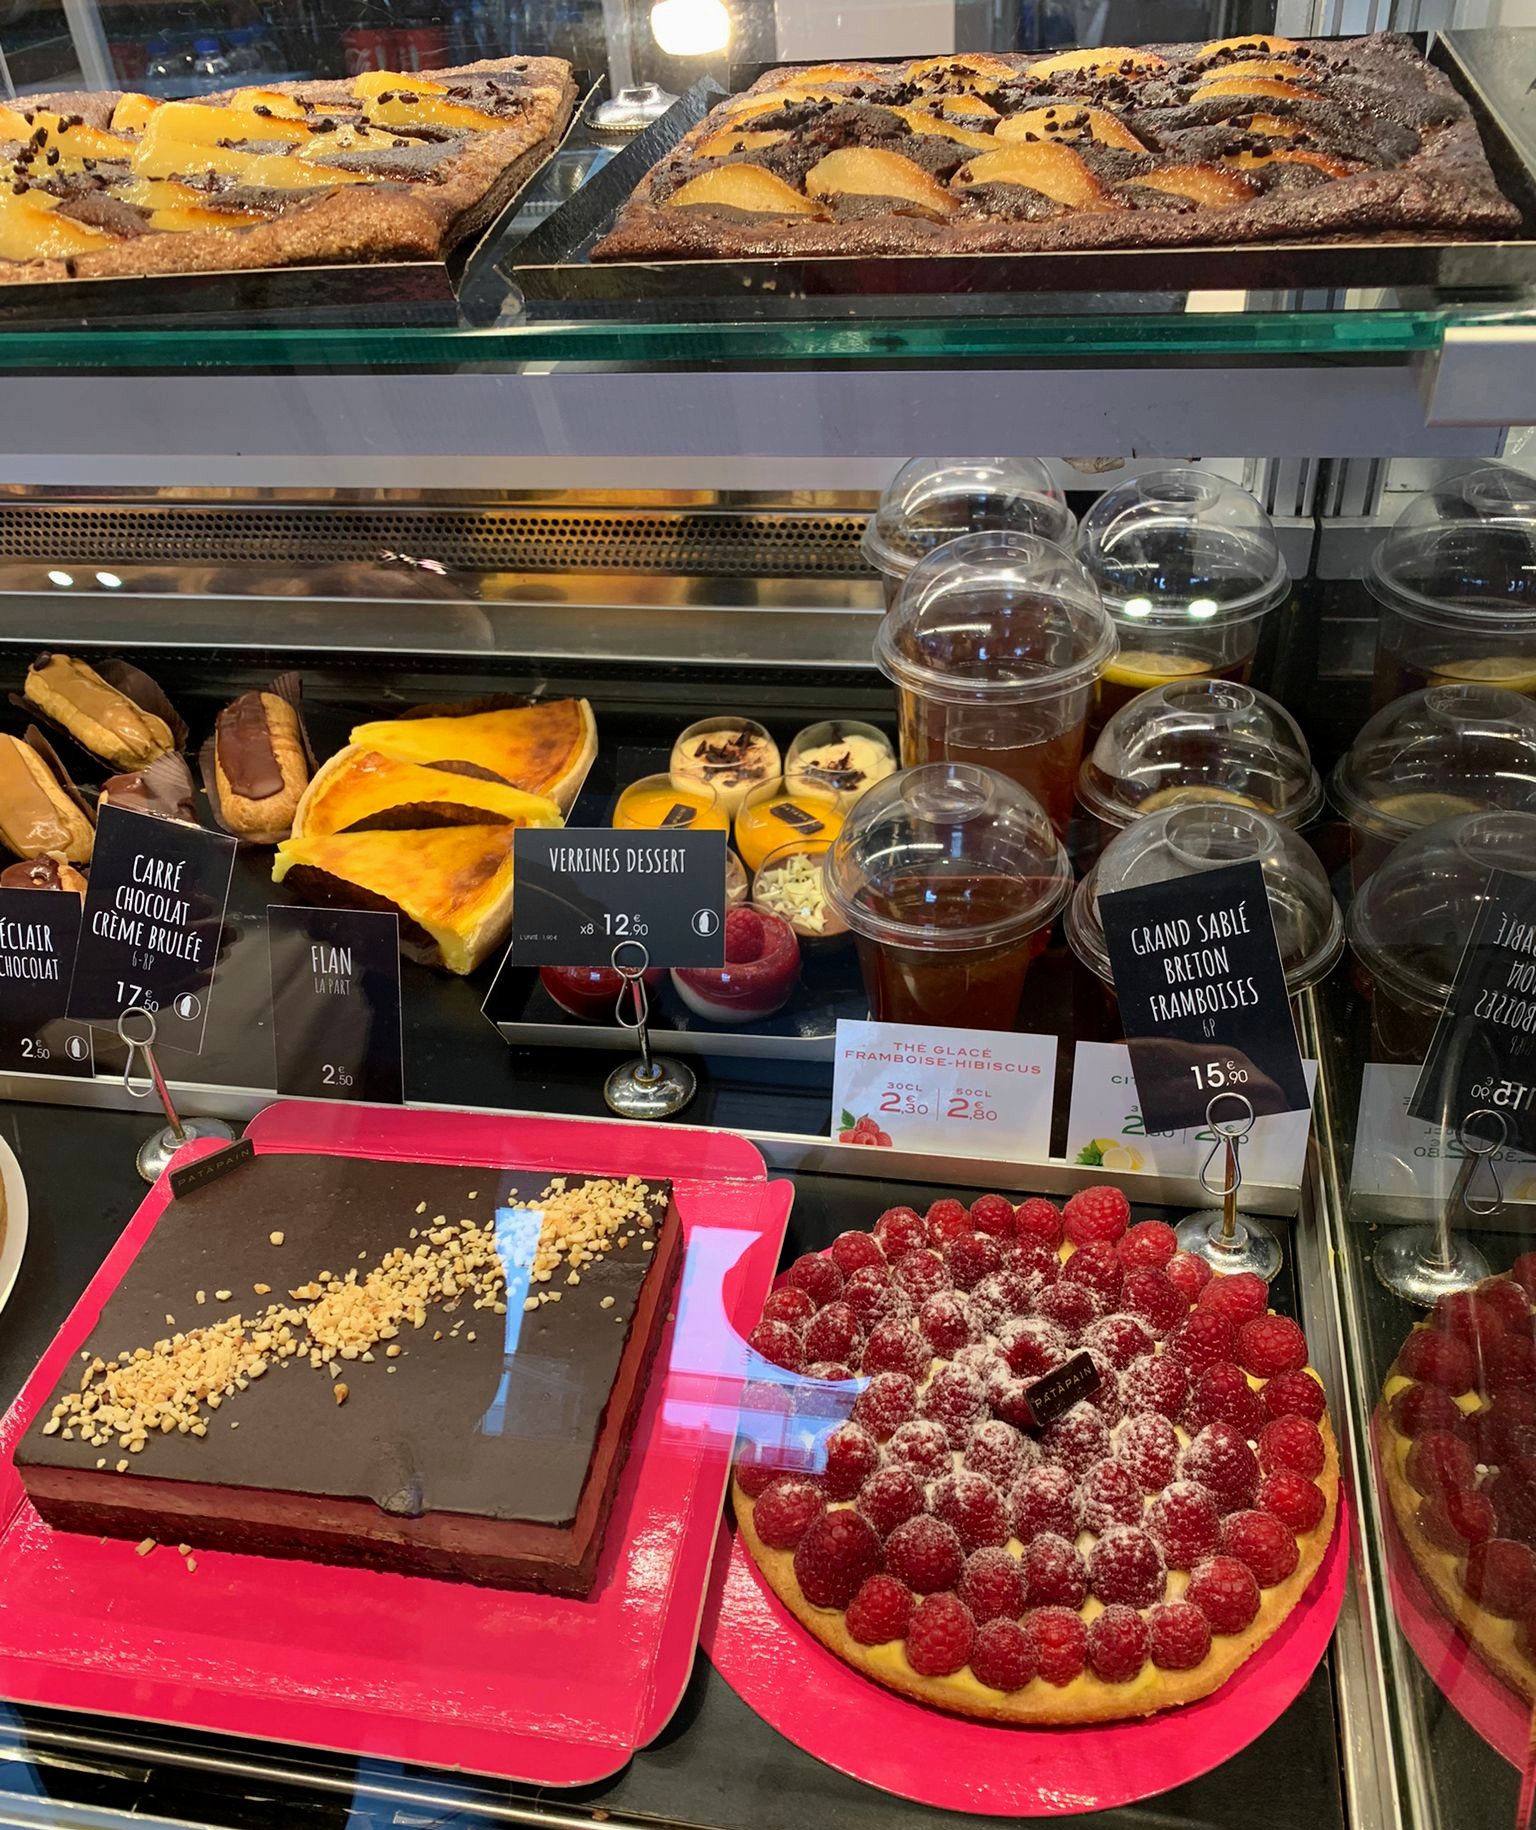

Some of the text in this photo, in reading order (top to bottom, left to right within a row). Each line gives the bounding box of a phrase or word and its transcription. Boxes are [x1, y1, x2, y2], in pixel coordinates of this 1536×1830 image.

[132, 854, 186, 893] CARRÉ
[549, 847, 686, 873] VERRINES DESSERT
[115, 885, 190, 926] CHOCOLAT
[0, 916, 54, 952] ÉCLAIR
[92, 910, 203, 962] CRÈME BRULÉE
[1130, 900, 1251, 956] GRAND SABLÉ
[132, 950, 155, 971] 6-8P
[311, 945, 352, 976] FLAN
[1163, 946, 1230, 985] BRETON
[314, 977, 351, 996] LA PART
[1149, 977, 1259, 1022] FRAMBOISES
[1202, 1017, 1216, 1038] 6P
[844, 1050, 1041, 1075] FRAMBOISE-HIBISCUS
[893, 1041, 992, 1059] THÉ GLACÉ
[887, 1081, 923, 1093] 30CL
[955, 1087, 993, 1099] 50CL
